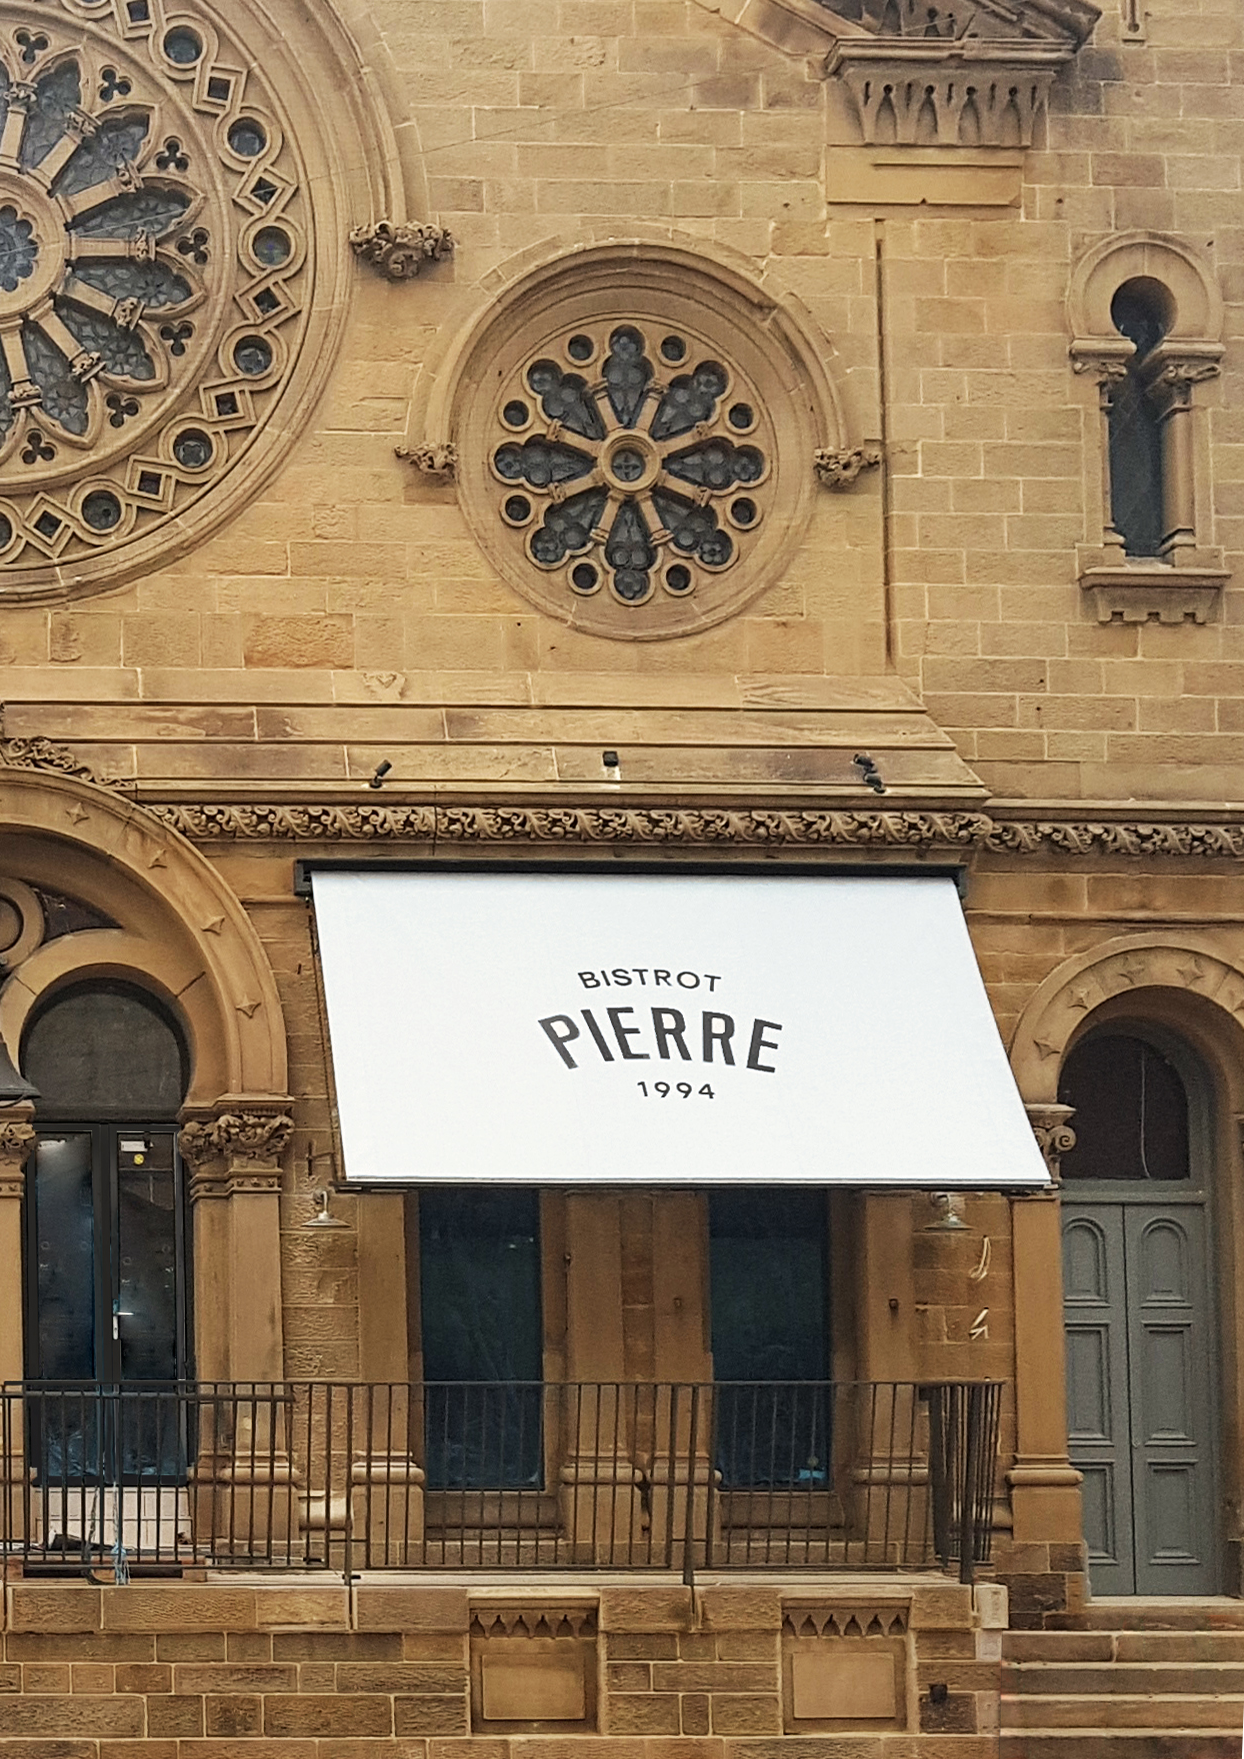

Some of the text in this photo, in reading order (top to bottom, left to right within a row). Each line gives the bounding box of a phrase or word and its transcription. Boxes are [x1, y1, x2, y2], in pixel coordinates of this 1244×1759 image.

[577, 968, 722, 992] BISTROT
[537, 1006, 783, 1074] PIERRE
[637, 1081, 716, 1100] 1994
